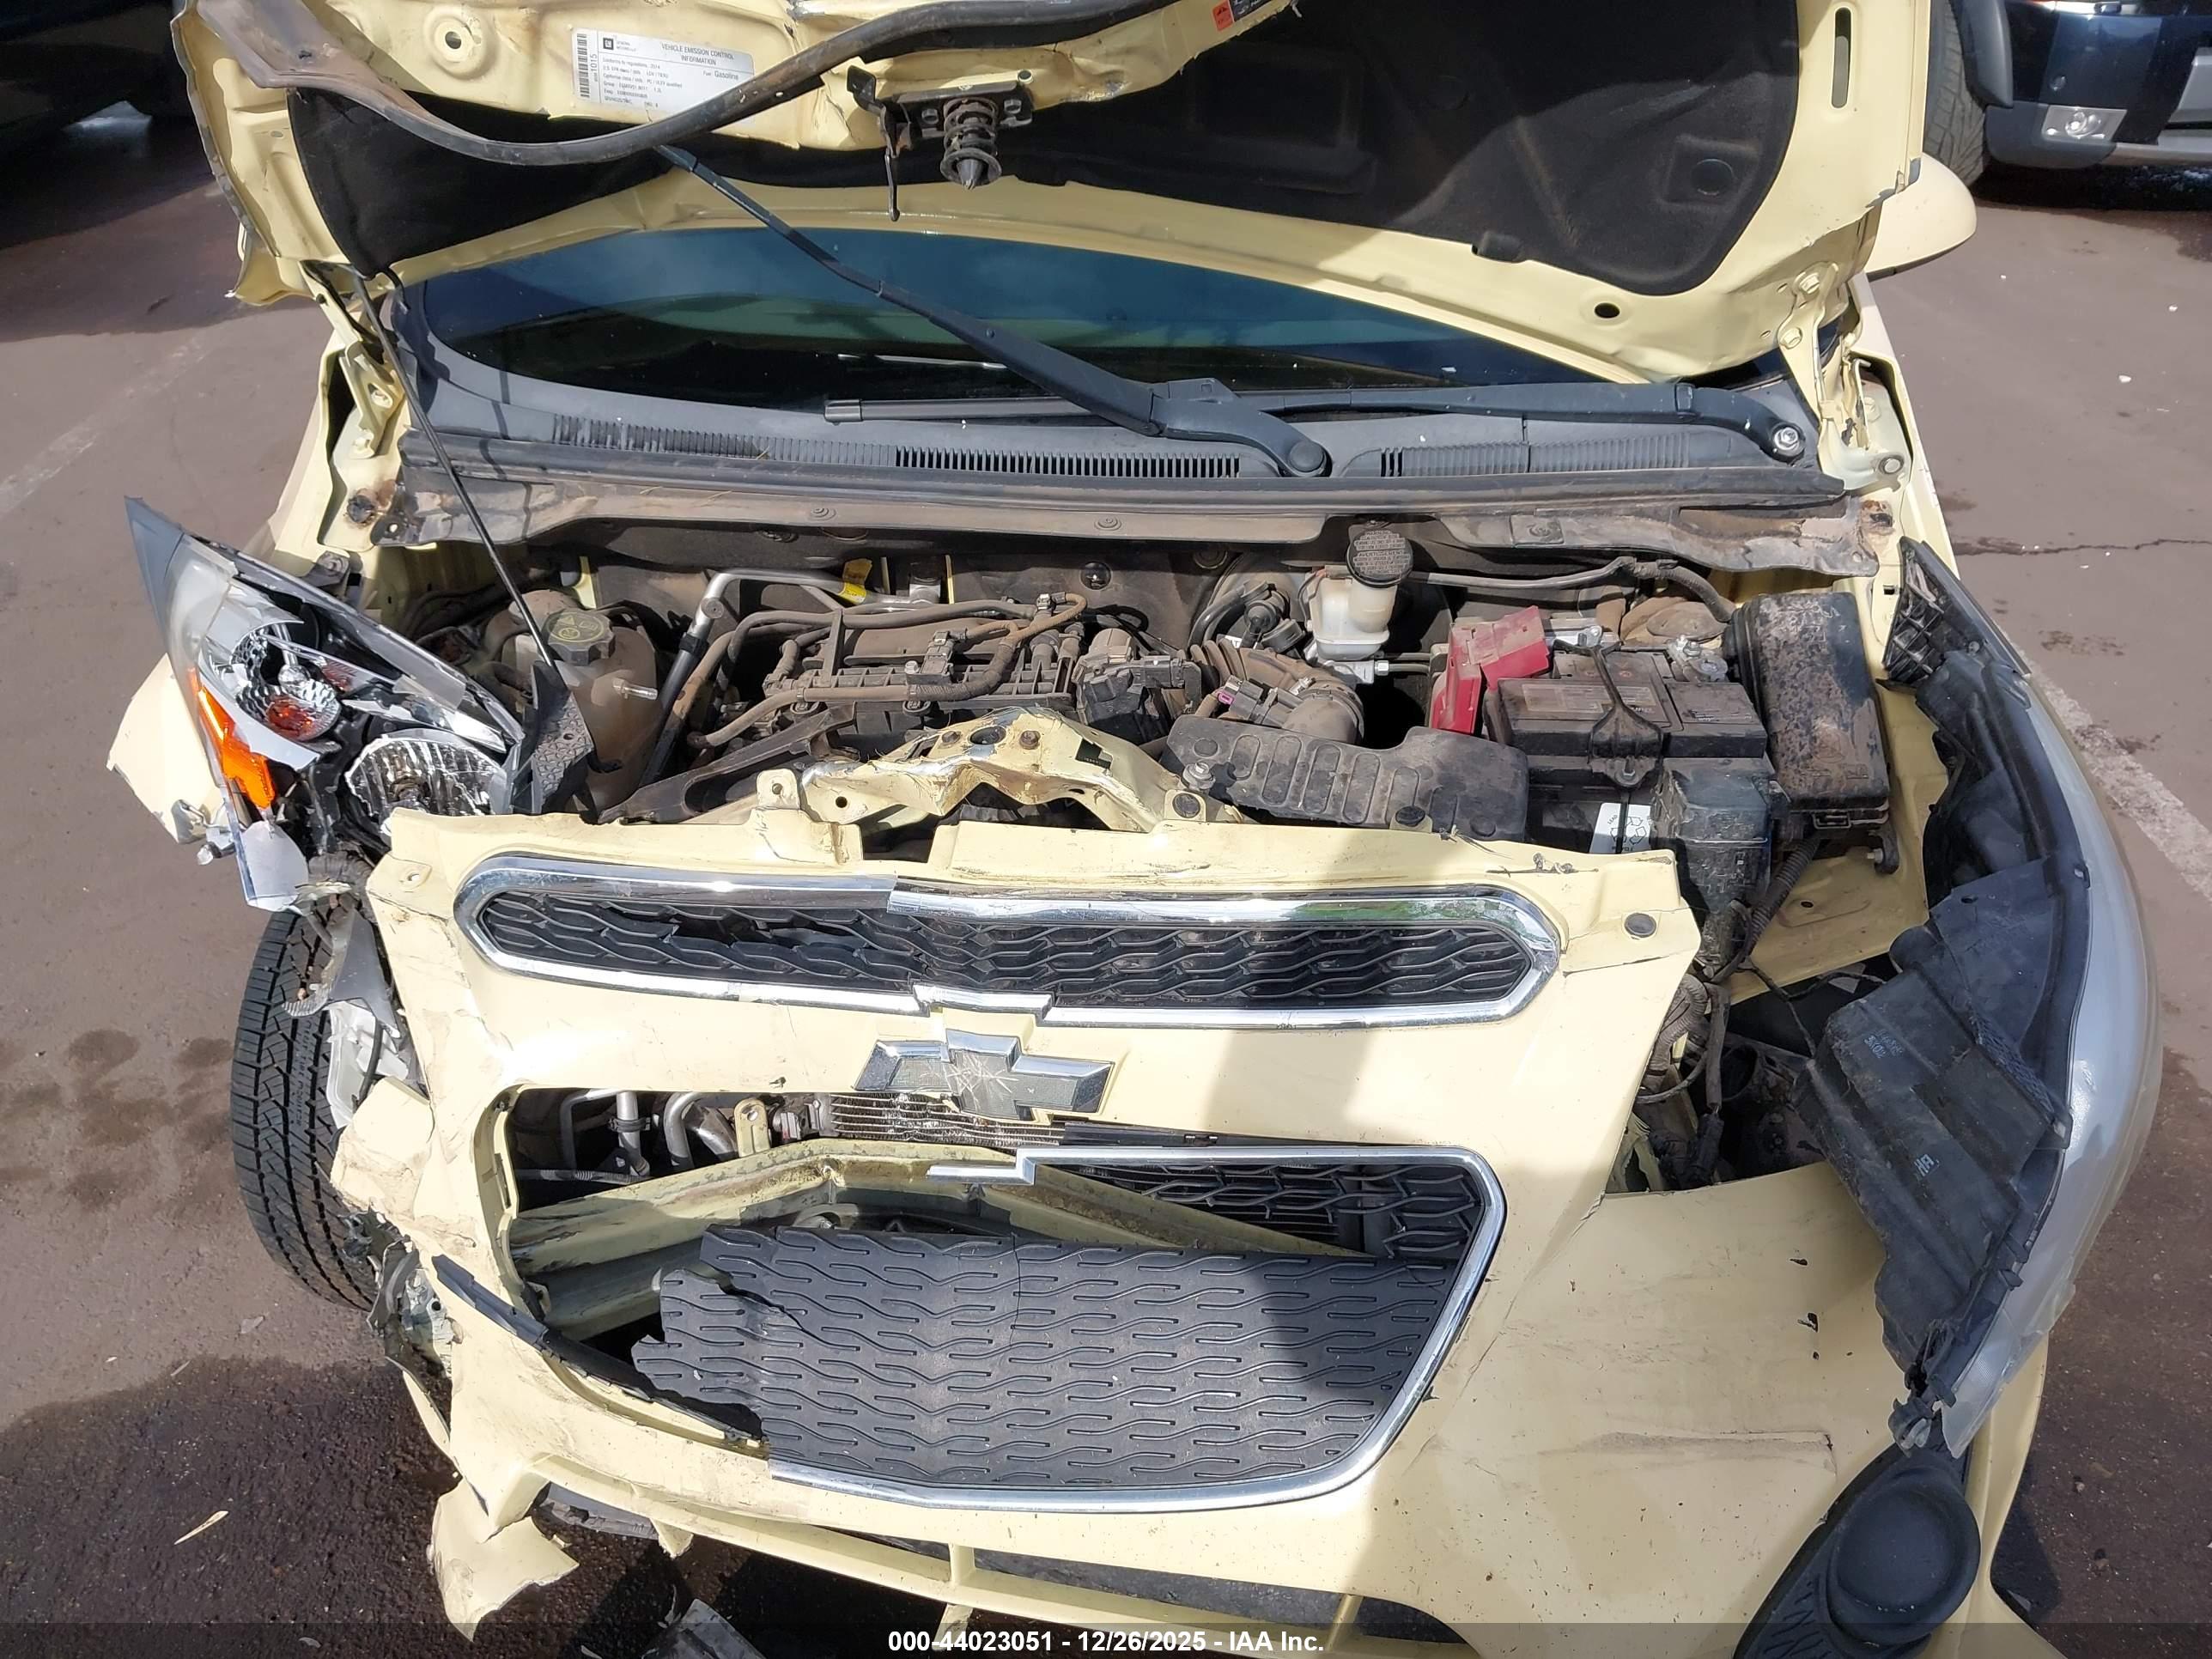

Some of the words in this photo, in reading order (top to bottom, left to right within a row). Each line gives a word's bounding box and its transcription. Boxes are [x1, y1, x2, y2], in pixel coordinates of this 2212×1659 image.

[661, 43, 683, 52] VEHICLE
[684, 46, 709, 56] EMISSION
[710, 50, 734, 60] CONTROL
[681, 55, 716, 65] INFORMATION
[714, 70, 738, 80] Gasoline
